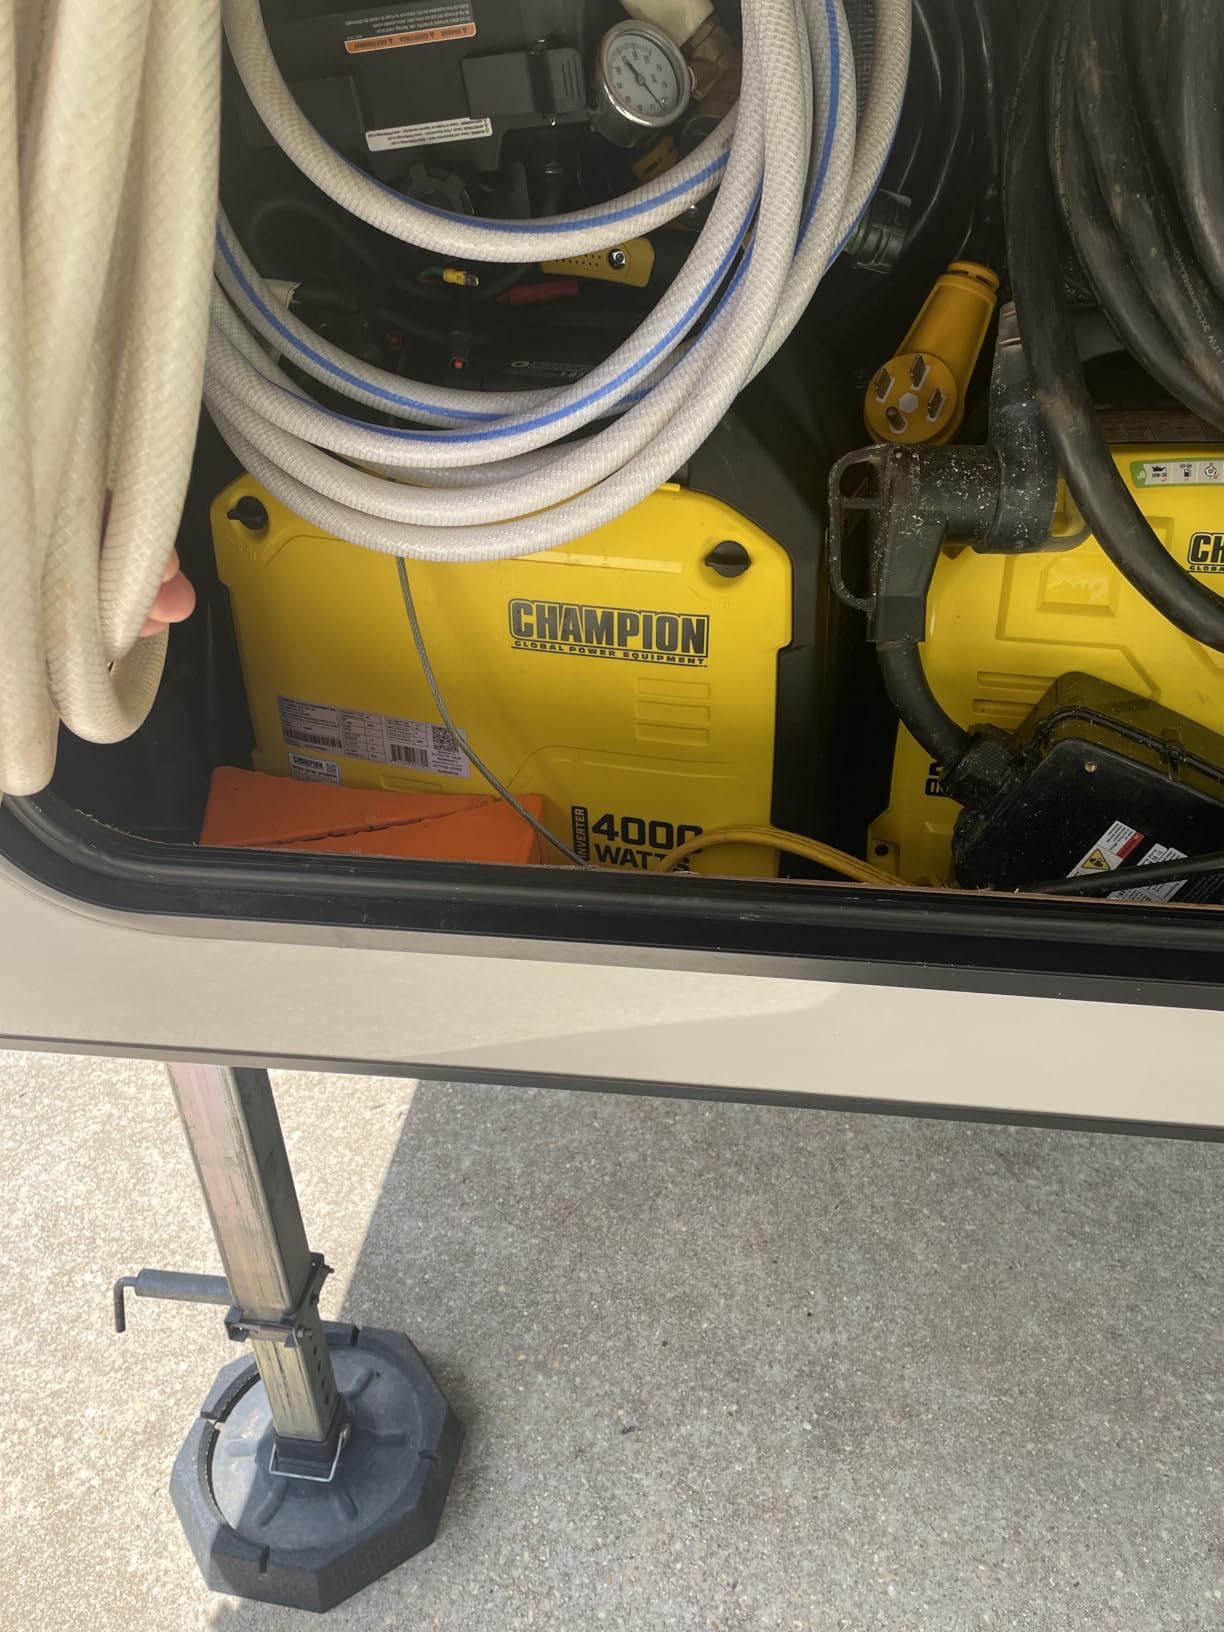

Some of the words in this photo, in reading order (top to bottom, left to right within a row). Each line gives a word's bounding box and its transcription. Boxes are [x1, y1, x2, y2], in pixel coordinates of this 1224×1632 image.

[510, 599, 708, 657] CHAMPION
[514, 640, 564, 652] GLOBAL
[569, 646, 616, 657] POWER
[623, 651, 705, 665] EQUIPMENT
